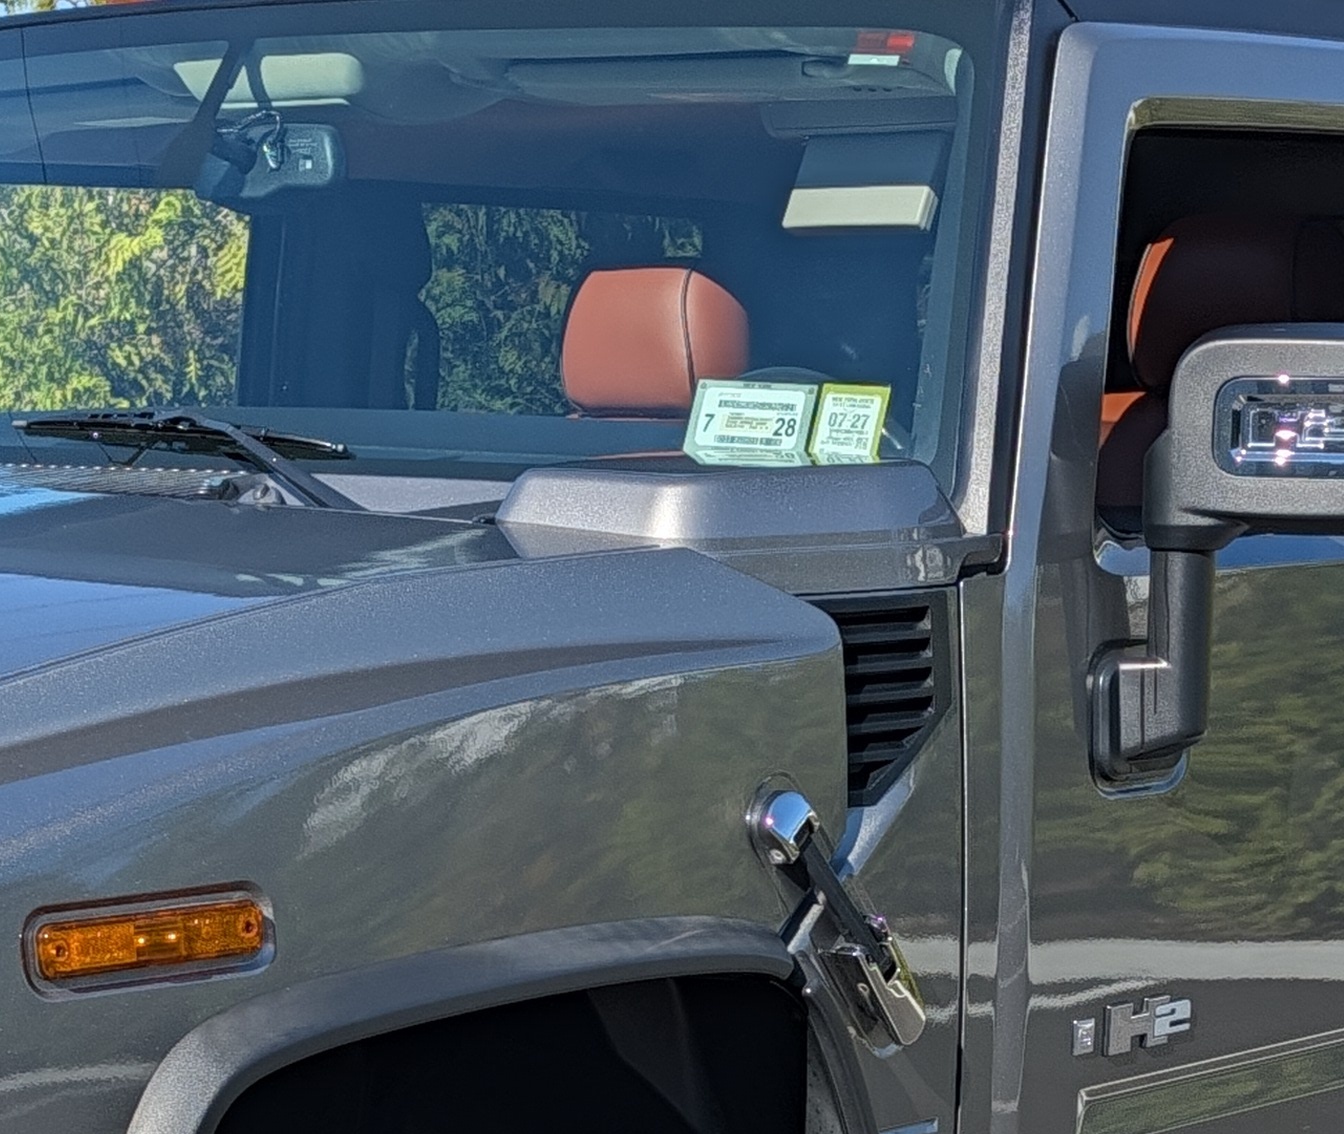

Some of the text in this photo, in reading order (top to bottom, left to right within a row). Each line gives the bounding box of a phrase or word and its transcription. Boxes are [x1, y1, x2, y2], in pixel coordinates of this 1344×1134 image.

[703, 413, 716, 433] 7
[772, 418, 797, 437] 28
[1105, 995, 1191, 1056] H2
